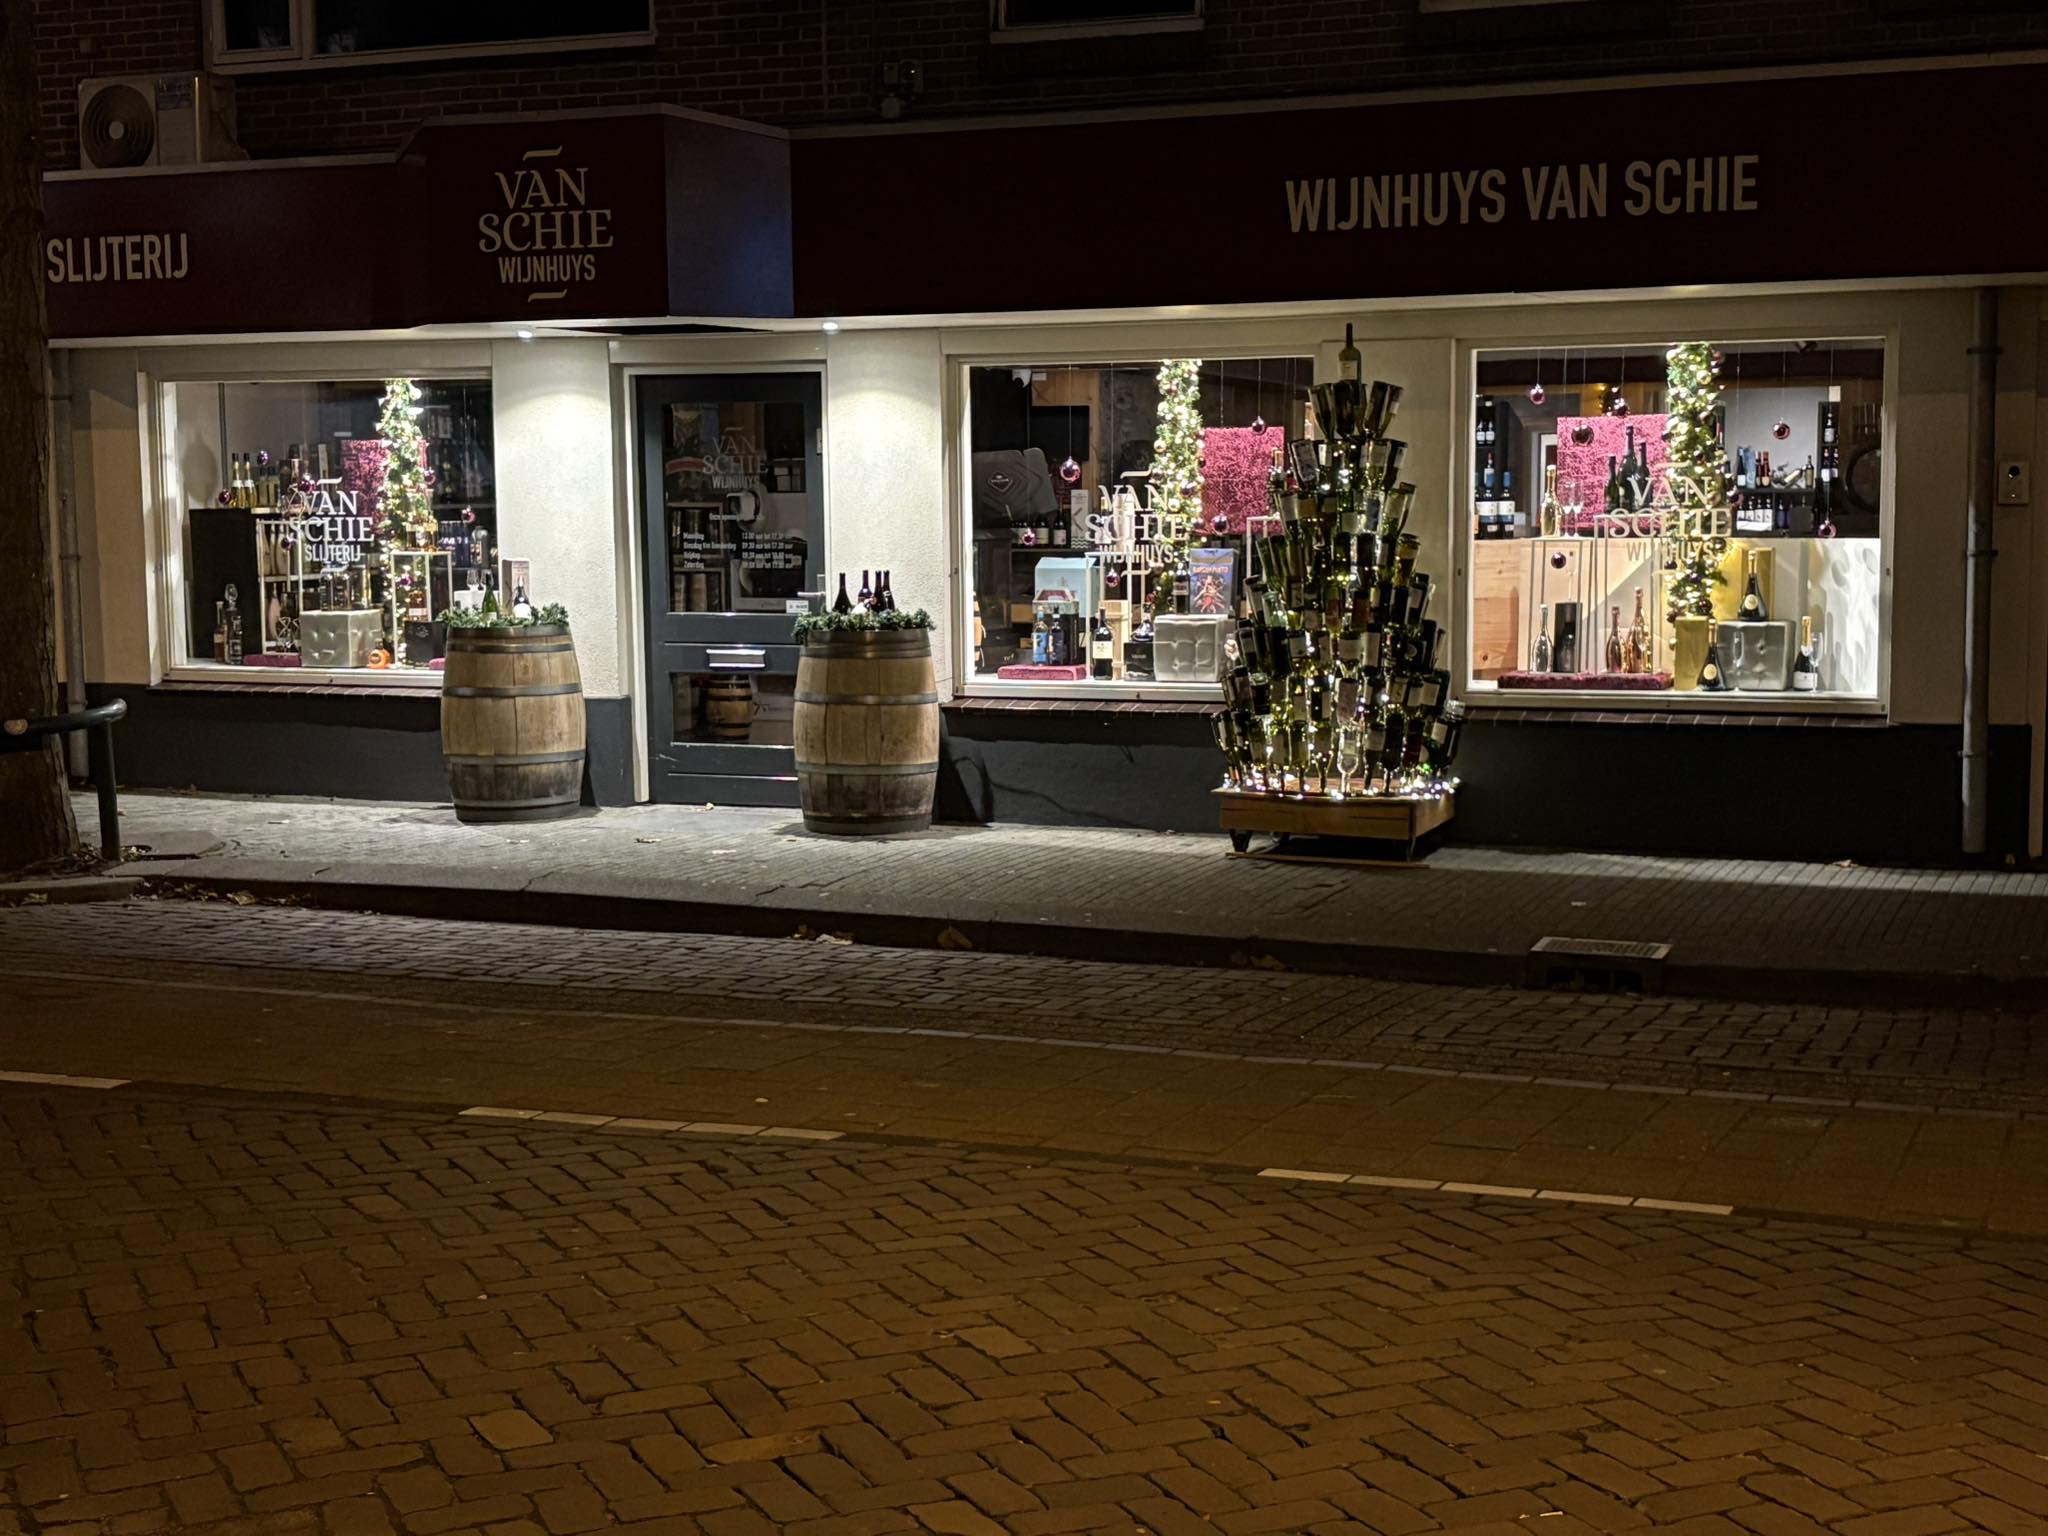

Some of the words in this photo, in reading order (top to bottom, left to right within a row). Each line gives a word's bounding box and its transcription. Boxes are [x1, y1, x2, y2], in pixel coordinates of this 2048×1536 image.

[494, 167, 589, 210] VAN
[1285, 168, 1507, 233] WIJNHUYS
[1521, 162, 1609, 222] VAN
[1624, 154, 1759, 216] SCHIE
[479, 209, 614, 253] SCHIE
[47, 232, 189, 283] SLIJTERIJ
[498, 253, 596, 284] WIJNHUYS
[712, 435, 756, 454] VAN
[703, 454, 768, 475] SCHIE
[299, 490, 359, 515] VAN
[1098, 484, 1169, 512] VAN
[1627, 476, 1712, 507] VAN
[289, 516, 375, 542] SCHIE
[1085, 513, 1190, 542] SCHIE
[1609, 507, 1732, 538] SCHIE
[304, 544, 361, 563] SLIJTERIJ
